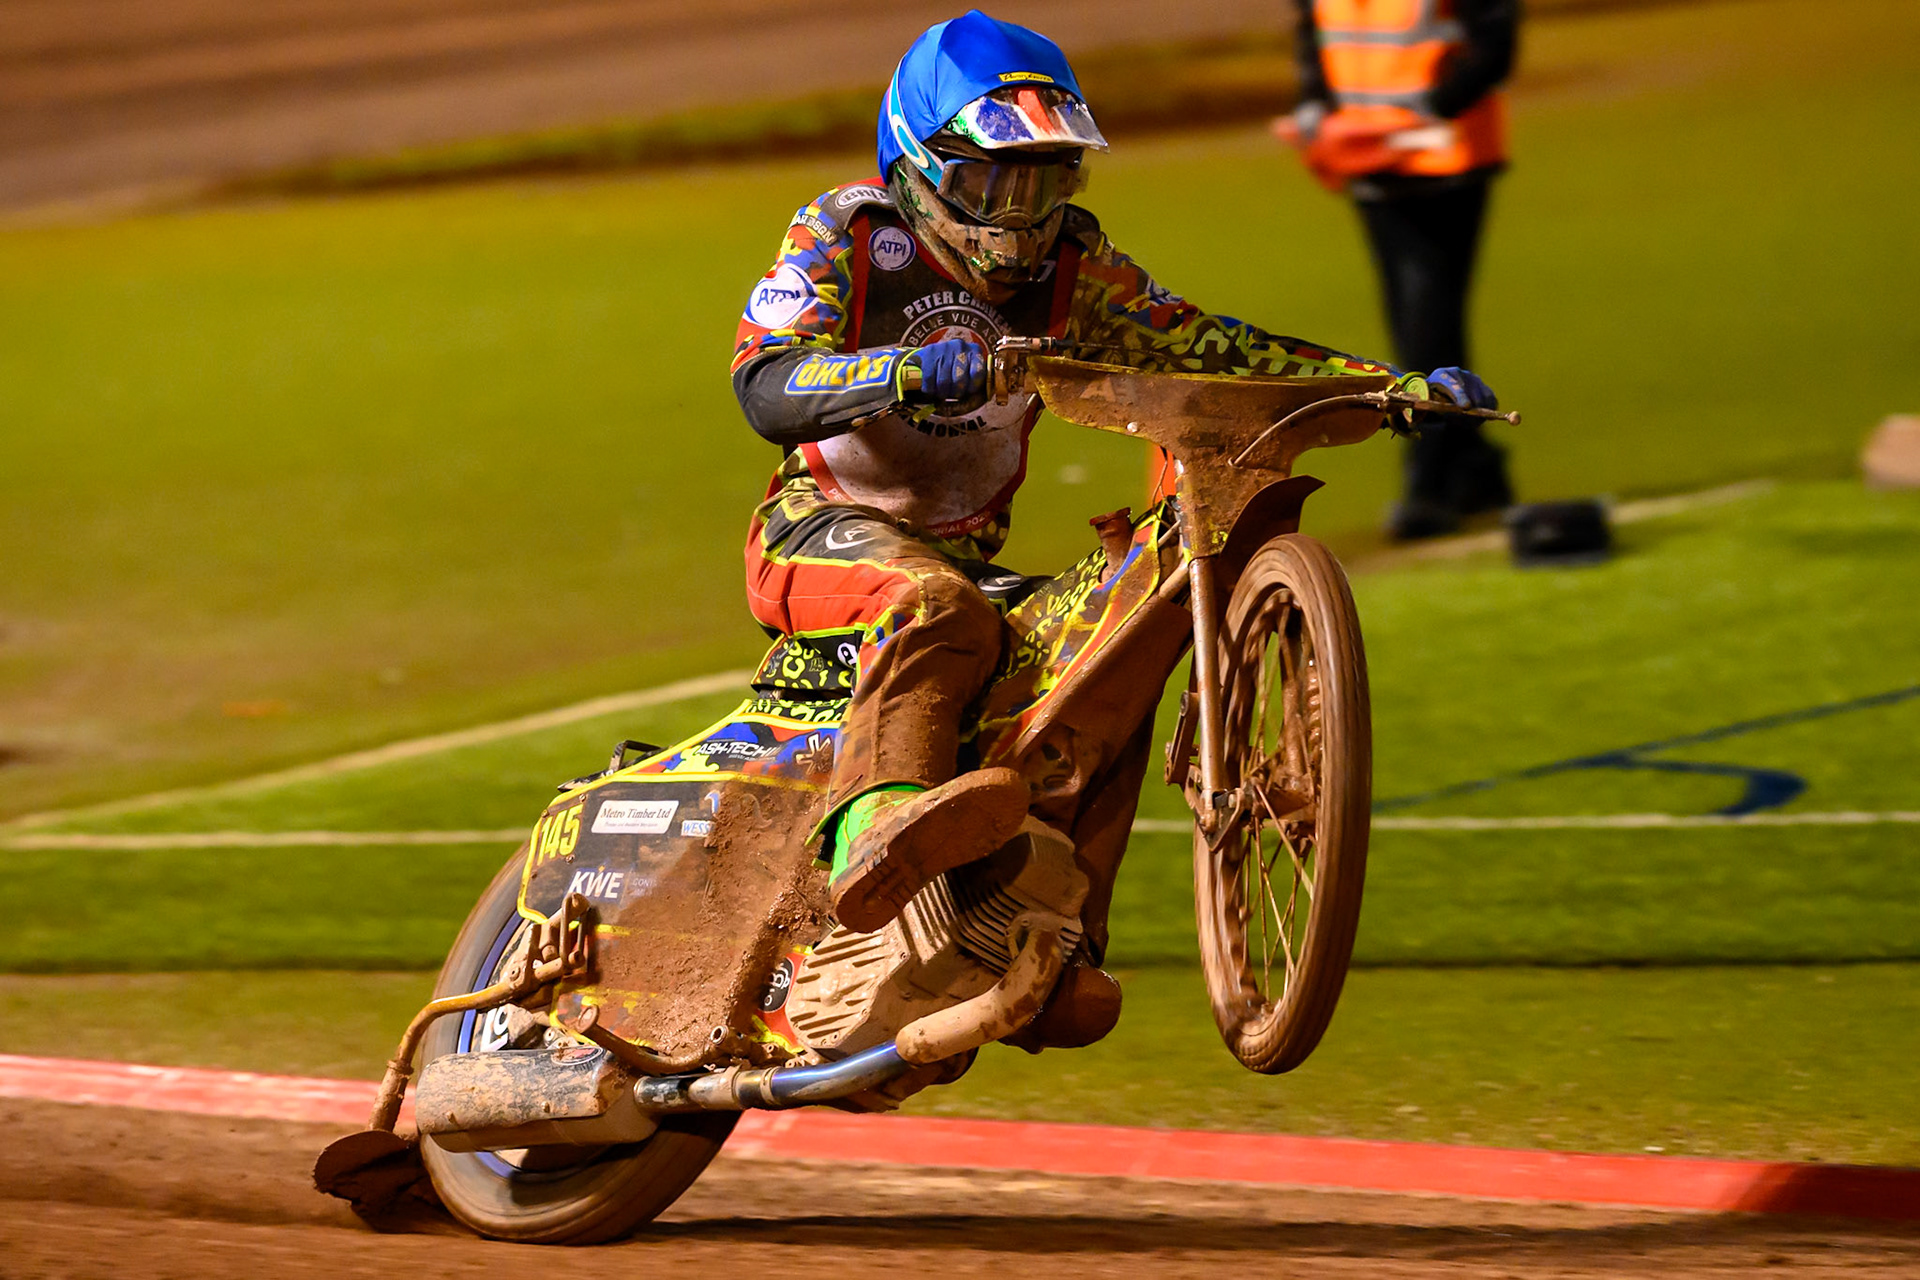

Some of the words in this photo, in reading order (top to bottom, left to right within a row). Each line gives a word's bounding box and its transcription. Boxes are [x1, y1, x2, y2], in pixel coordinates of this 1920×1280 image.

[877, 240, 907, 257] ATPI
[903, 290, 954, 320] PETER
[908, 315, 945, 347] BELLE
[951, 313, 979, 329] VUE
[600, 808, 626, 819] Metro
[627, 808, 656, 819] Timber
[656, 808, 672, 819] Ltd
[537, 804, 583, 866] 145
[564, 871, 625, 899] KWE
